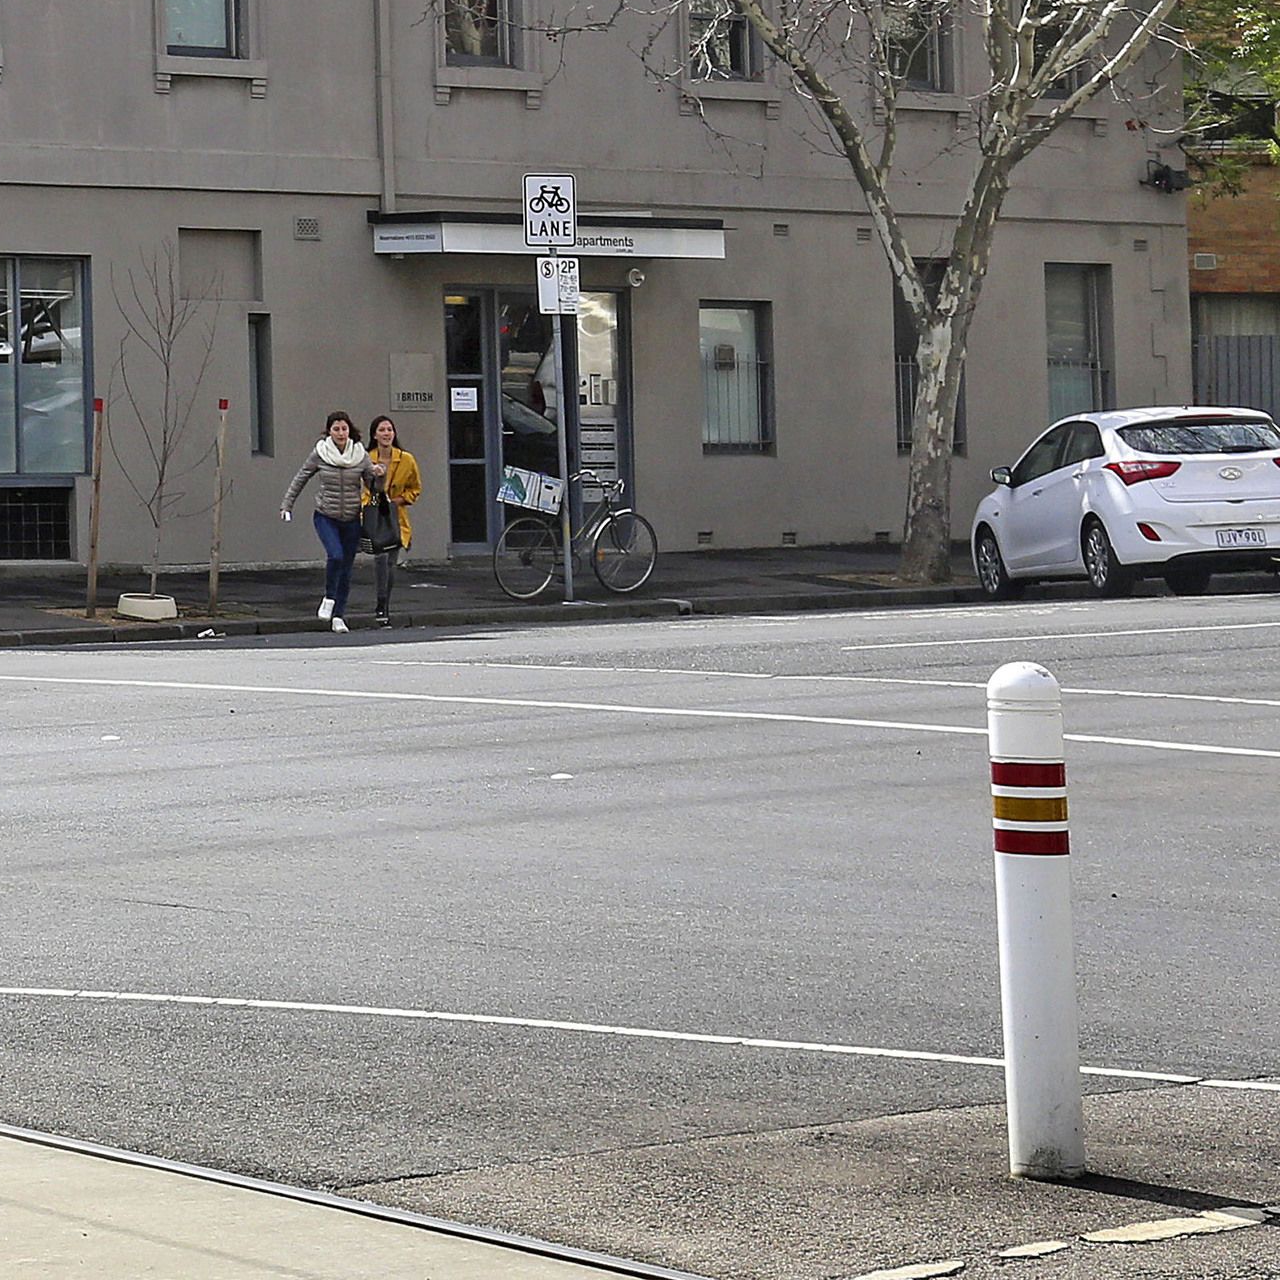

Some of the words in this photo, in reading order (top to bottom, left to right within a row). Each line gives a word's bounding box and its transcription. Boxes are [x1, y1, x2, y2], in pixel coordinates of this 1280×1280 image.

[529, 220, 572, 237] LANE
[576, 236, 634, 248] apartments
[561, 260, 576, 274] 2P
[401, 392, 434, 402] BRITISH
